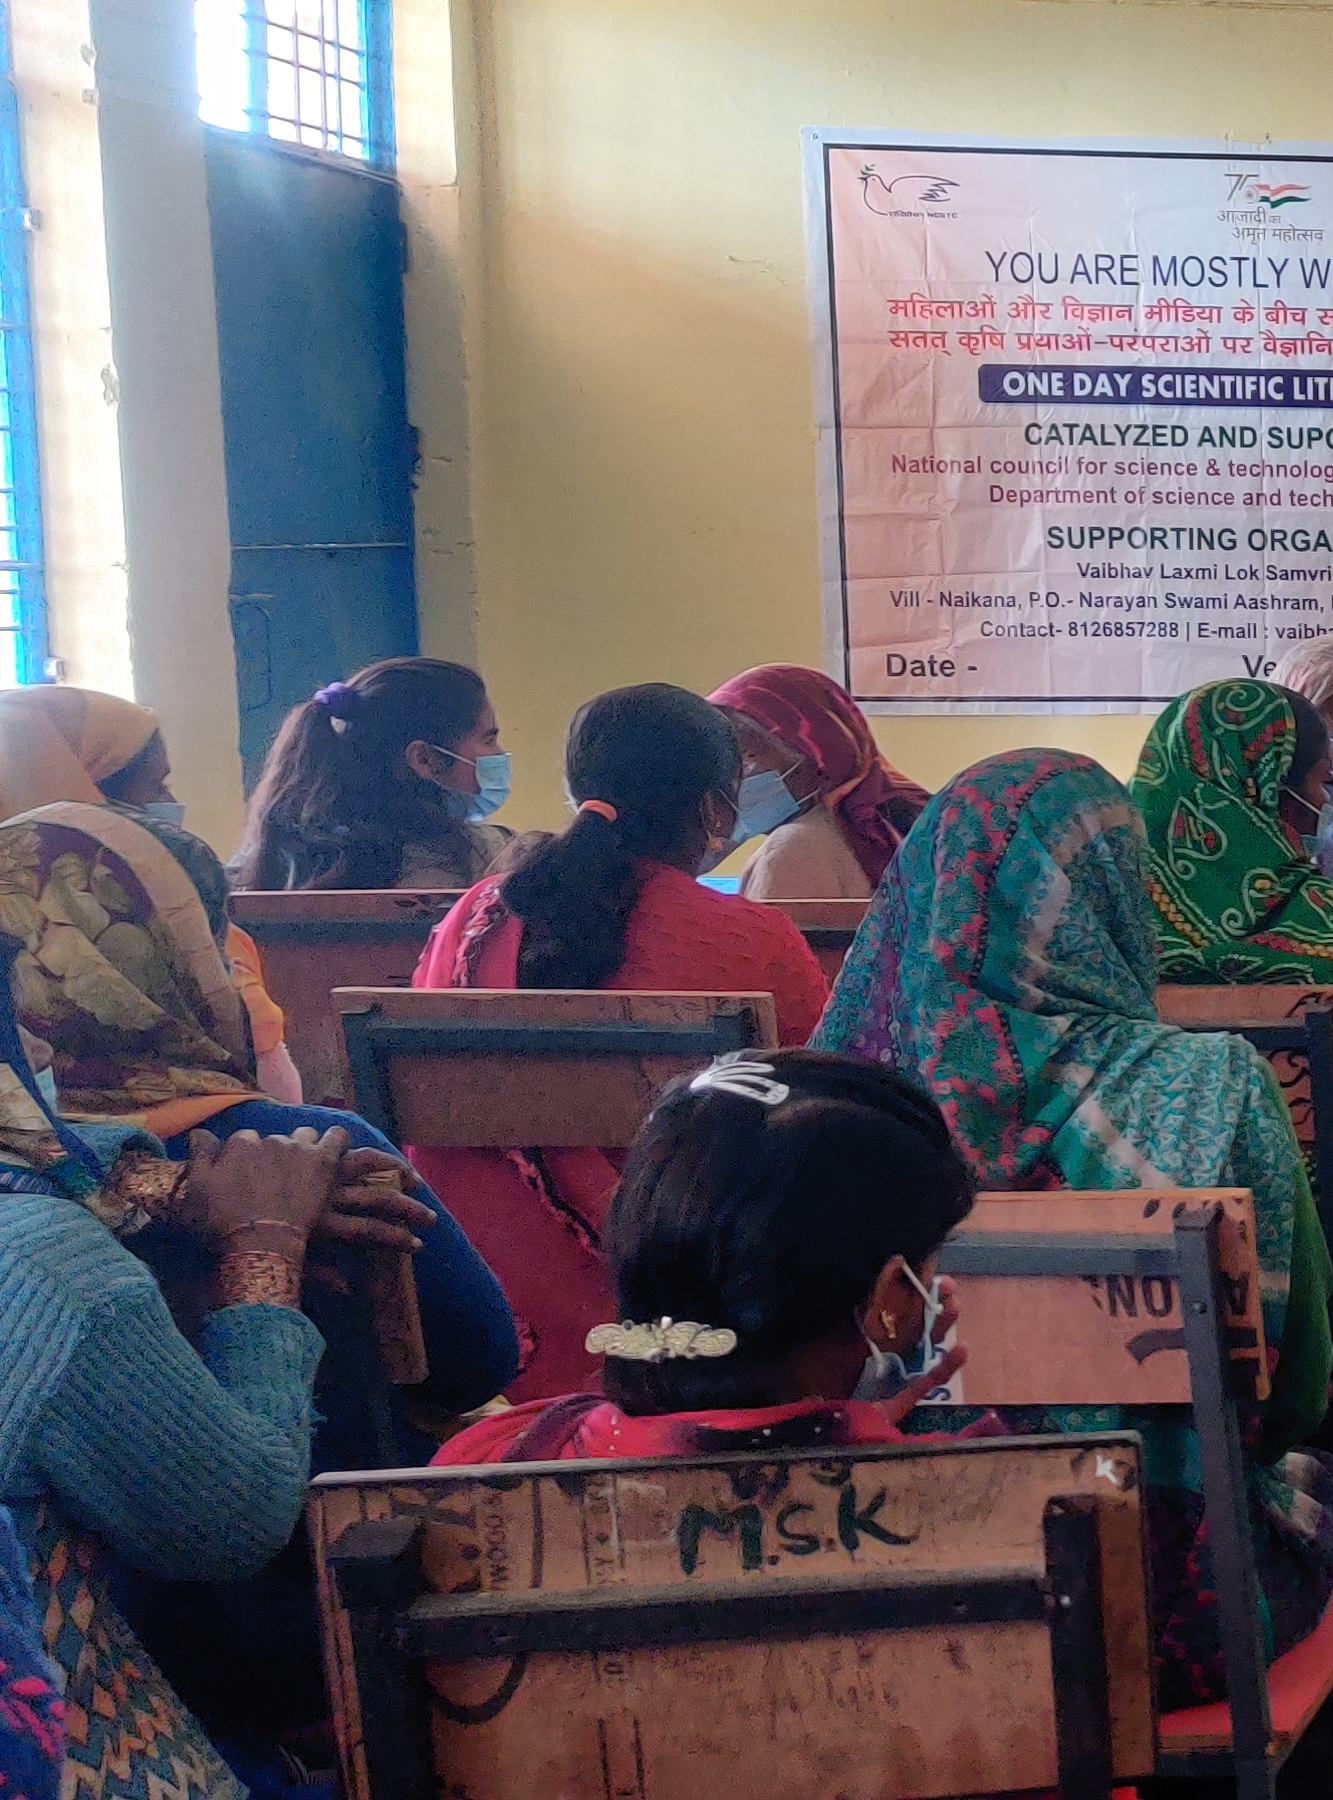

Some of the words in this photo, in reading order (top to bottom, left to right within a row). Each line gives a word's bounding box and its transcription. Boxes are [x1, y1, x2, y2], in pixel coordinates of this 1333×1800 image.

[1231, 226, 1267, 245] अमृत
[1271, 224, 1325, 243] महोत्सव
[985, 250, 1058, 284] YOU
[1069, 252, 1139, 286] ARE
[1151, 254, 1289, 290] MOSTLY
[886, 293, 997, 320] महिलाओं
[1007, 293, 1054, 321] और
[1061, 295, 1135, 323] विज्ञान
[1143, 297, 1224, 324] मीडिया
[1230, 298, 1256, 325] के
[1262, 299, 1308, 327] बीच
[887, 330, 952, 357] सतत्
[955, 324, 1007, 357] कृषि
[1220, 336, 1254, 354] पर
[1002, 370, 1064, 397] ONE
[1073, 372, 1133, 398] DAY
[1141, 373, 1286, 400] SCIENTIFIC
[1024, 422, 1189, 448] CATALYZED
[1197, 426, 1258, 449] AND
[892, 455, 982, 475] National
[990, 456, 1069, 475] council
[1076, 456, 1107, 475] for
[1114, 457, 1198, 477] science
[1205, 458, 1221, 477] &
[990, 485, 1117, 506] Department
[1124, 484, 1147, 506] of
[1152, 485, 1235, 508] science
[1243, 485, 1282, 508] and
[1046, 525, 1237, 551] SUPPORTING
[1077, 562, 1154, 580] Vaibhav
[1160, 563, 1218, 581] Laxmi
[1225, 563, 1259, 581] Lok
[889, 590, 920, 608] Vill
[939, 590, 1022, 611] Naikana,
[1029, 592, 1073, 609] P.O.-
[1079, 592, 1158, 613] Narayan
[1164, 592, 1228, 610] Swami
[1233, 594, 1325, 613] Aashram,
[981, 620, 1062, 638] Contact-
[1068, 622, 1180, 638] 8126857288
[1197, 622, 1258, 639] E-mail
[886, 653, 956, 678] Date
